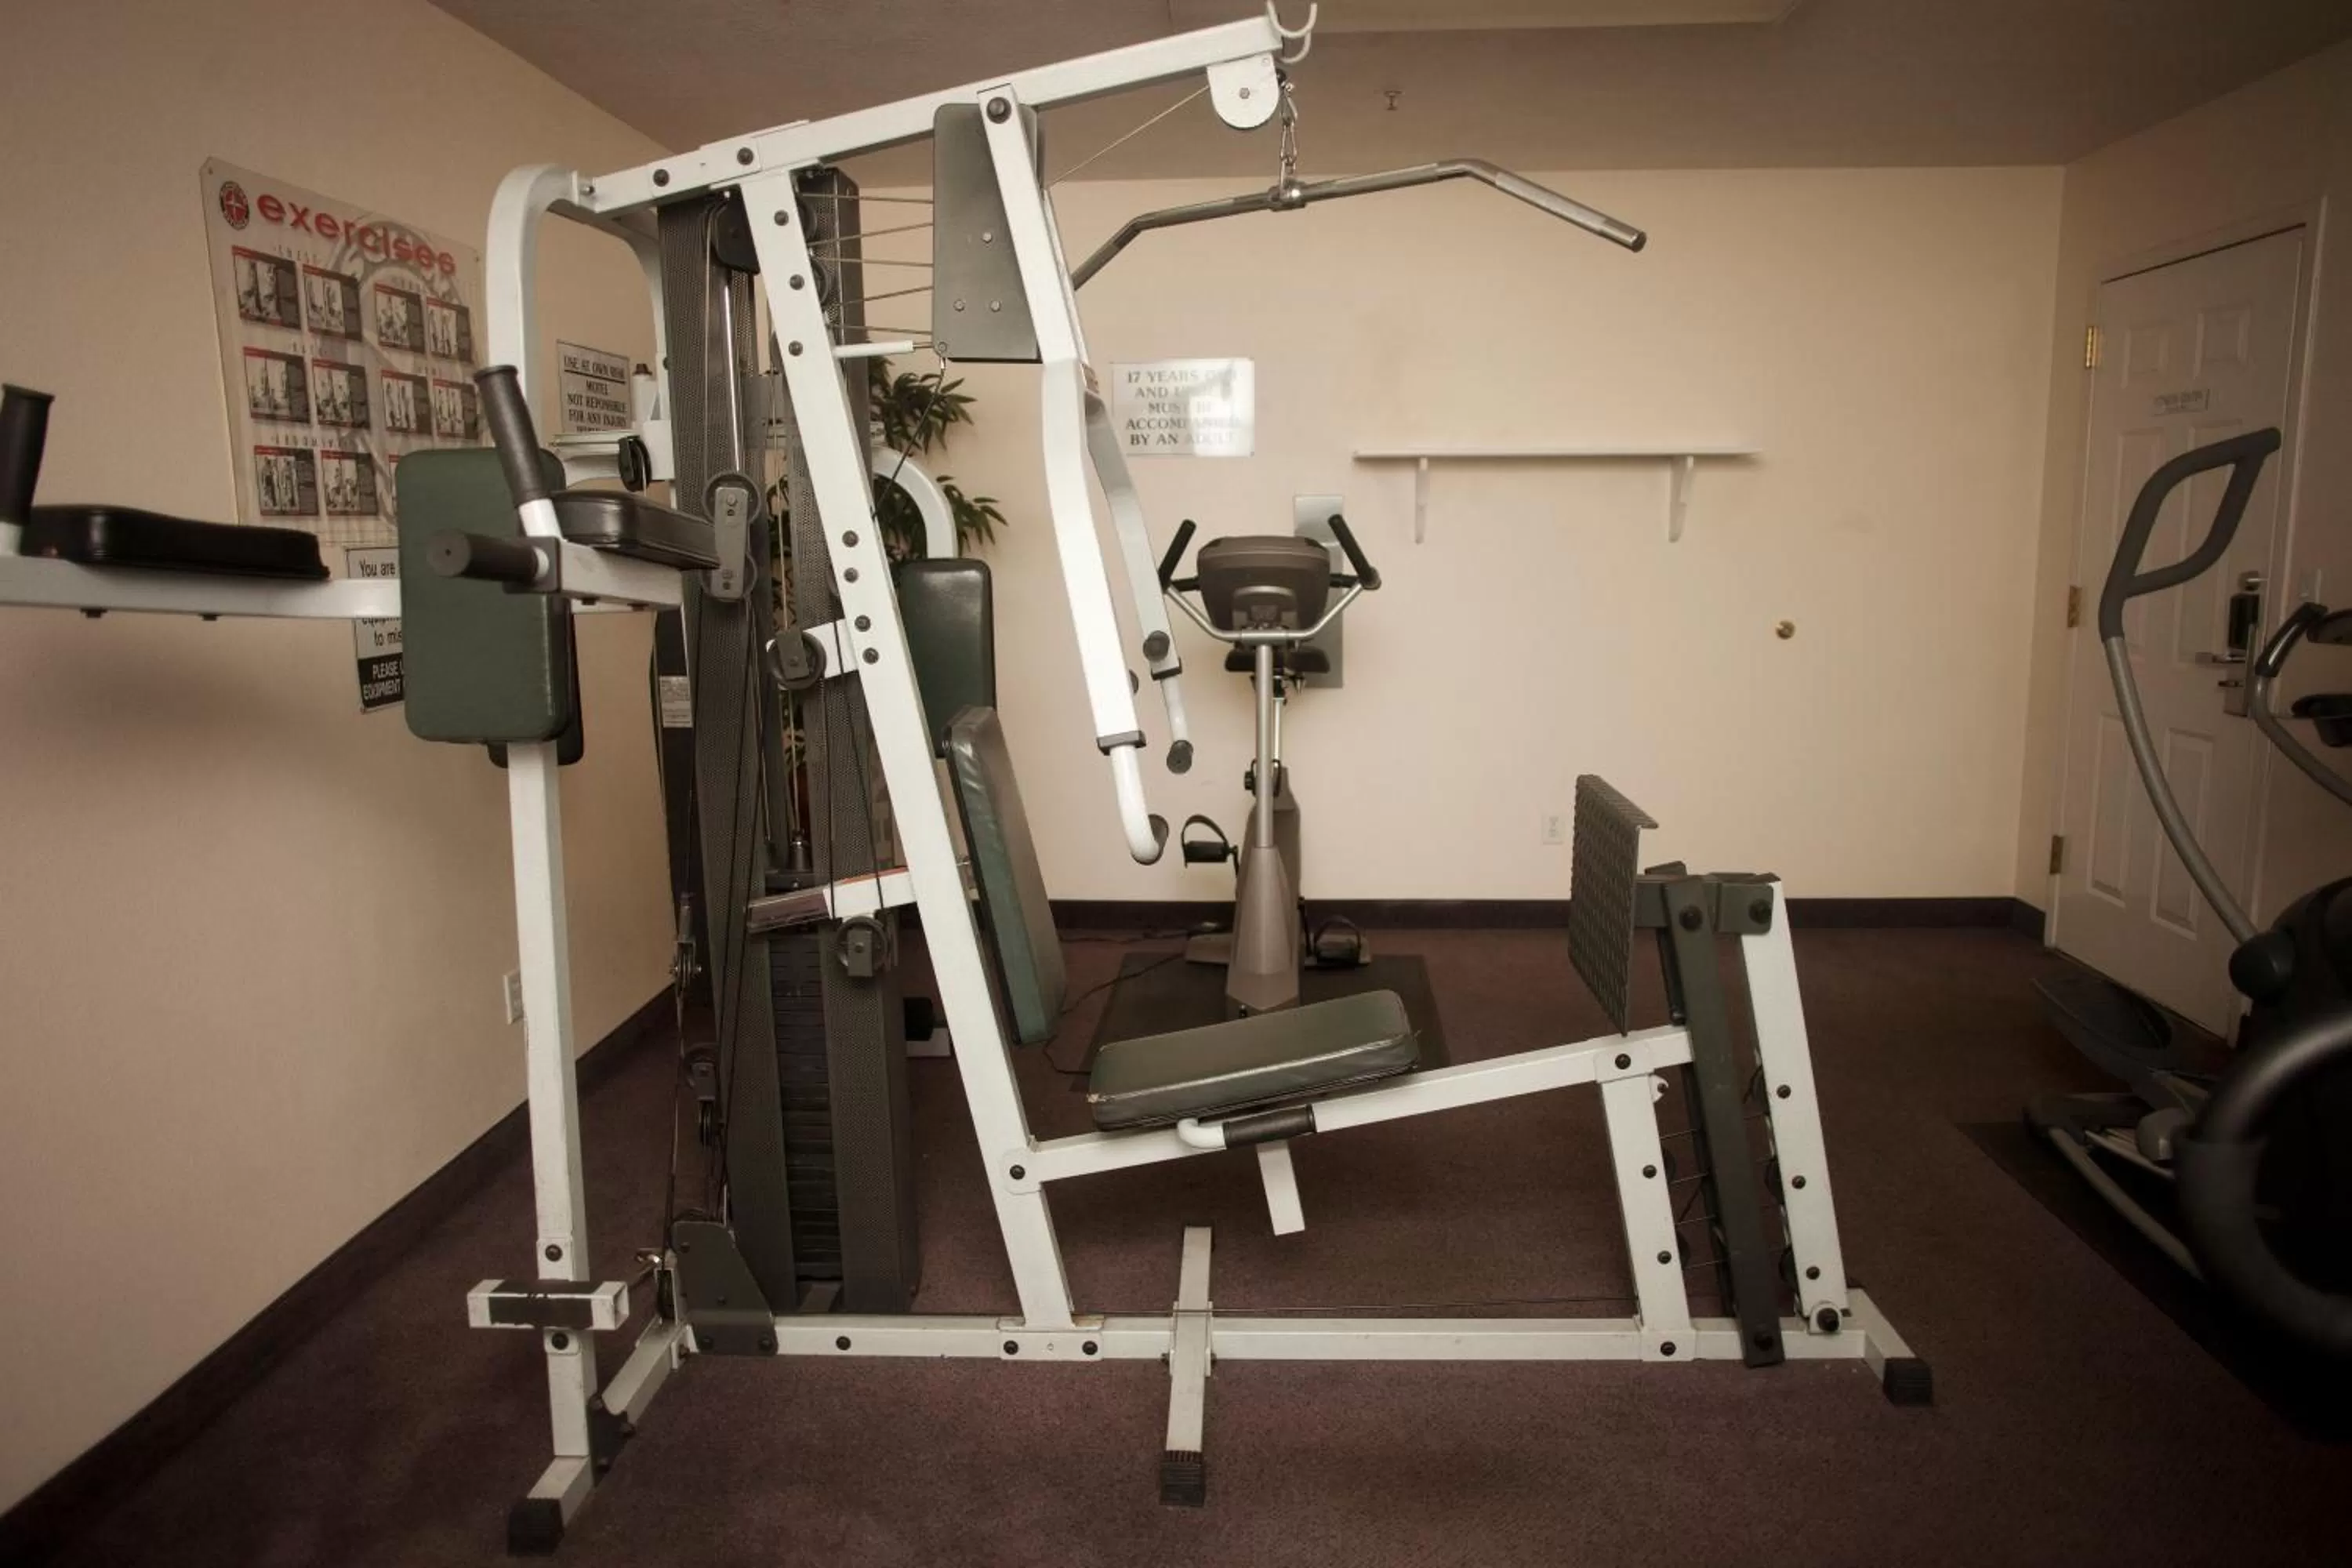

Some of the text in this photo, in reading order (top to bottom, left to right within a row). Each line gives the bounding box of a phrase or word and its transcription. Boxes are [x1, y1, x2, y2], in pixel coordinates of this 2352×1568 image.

[256, 193, 456, 277] exercises
[564, 355, 579, 370] USE
[592, 361, 609, 377] OWN
[1127, 371, 1141, 383] 17
[1146, 369, 1198, 383] YEARS
[586, 379, 608, 396] MOTEL
[1134, 387, 1169, 398] AND
[567, 393, 583, 406] NOT
[568, 408, 584, 423] FOR
[587, 412, 601, 424] ANY
[1130, 434, 1150, 446] BY
[1156, 433, 1178, 445] AN
[359, 559, 396, 578] You are
[374, 630, 384, 647] to
[372, 660, 398, 679] PLEASE
[363, 678, 401, 701] EQUIPMENT
